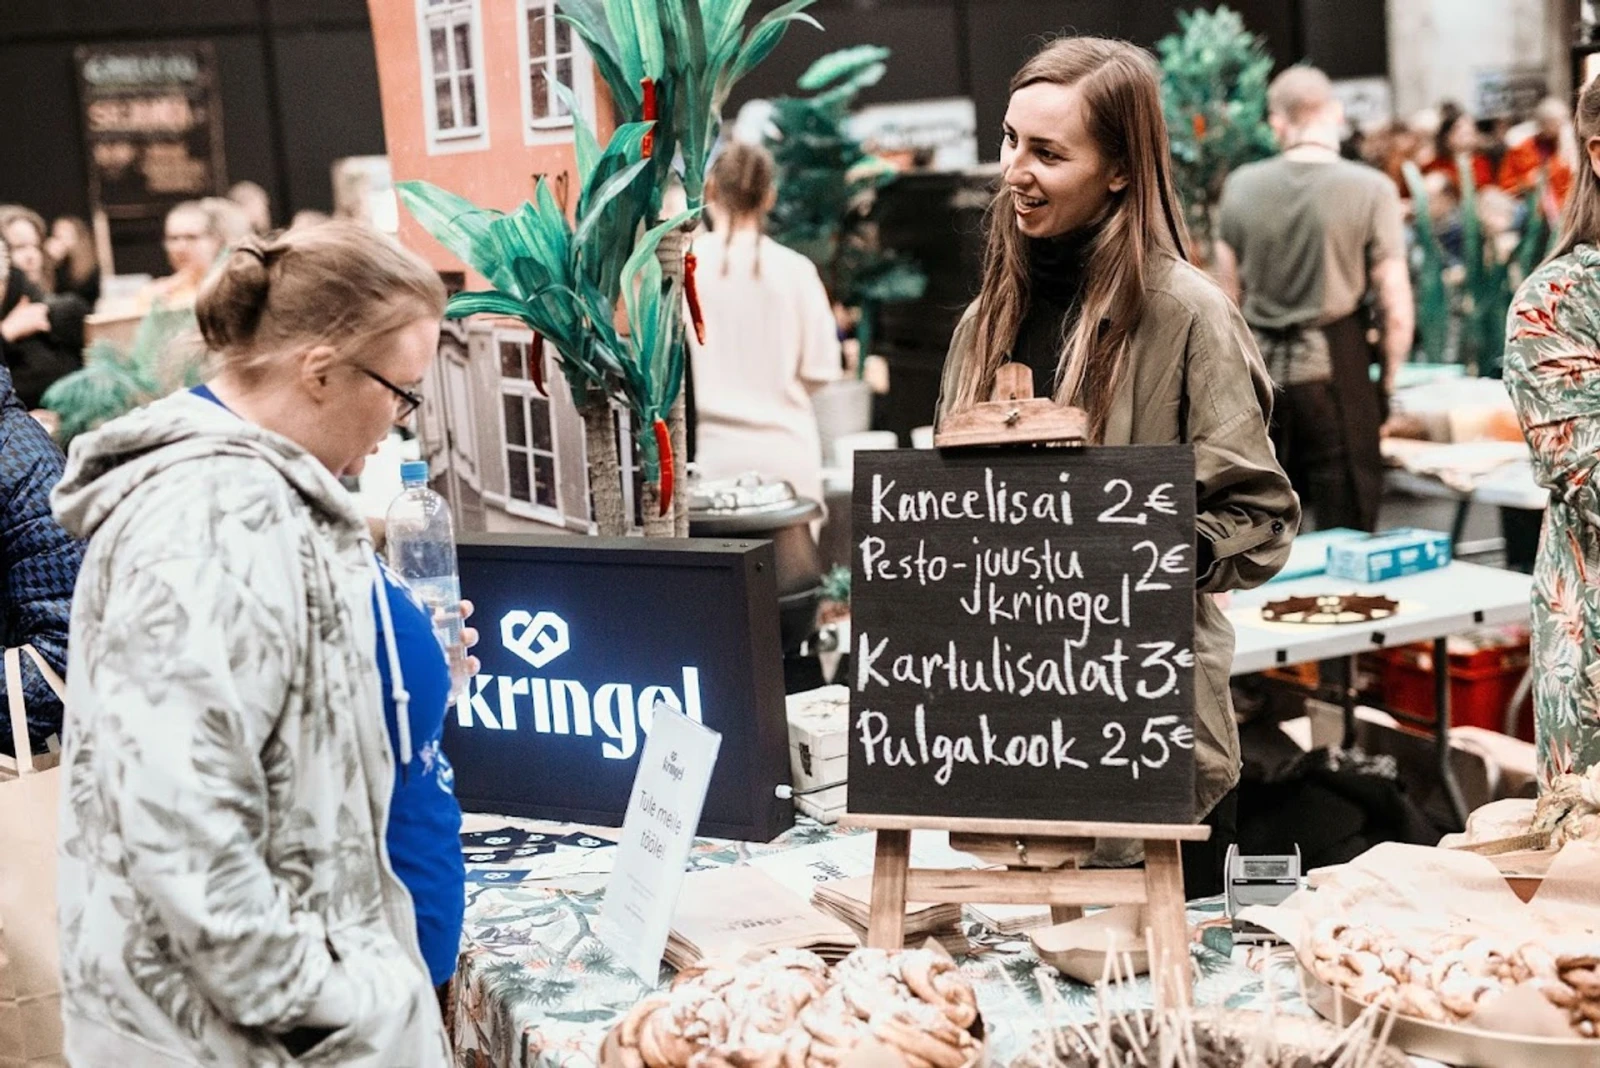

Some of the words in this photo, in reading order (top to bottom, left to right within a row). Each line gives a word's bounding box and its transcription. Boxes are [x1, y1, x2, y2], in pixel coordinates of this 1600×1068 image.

[872, 467, 1074, 525] Kaneelisai
[859, 535, 1084, 615] Pesto-juustu
[1132, 540, 1191, 592] 2€
[988, 573, 1130, 649] kringel
[857, 632, 1129, 702] Kartulisalat
[856, 703, 1089, 786] Pulgakook
[1100, 715, 1195, 780] 2,5€
